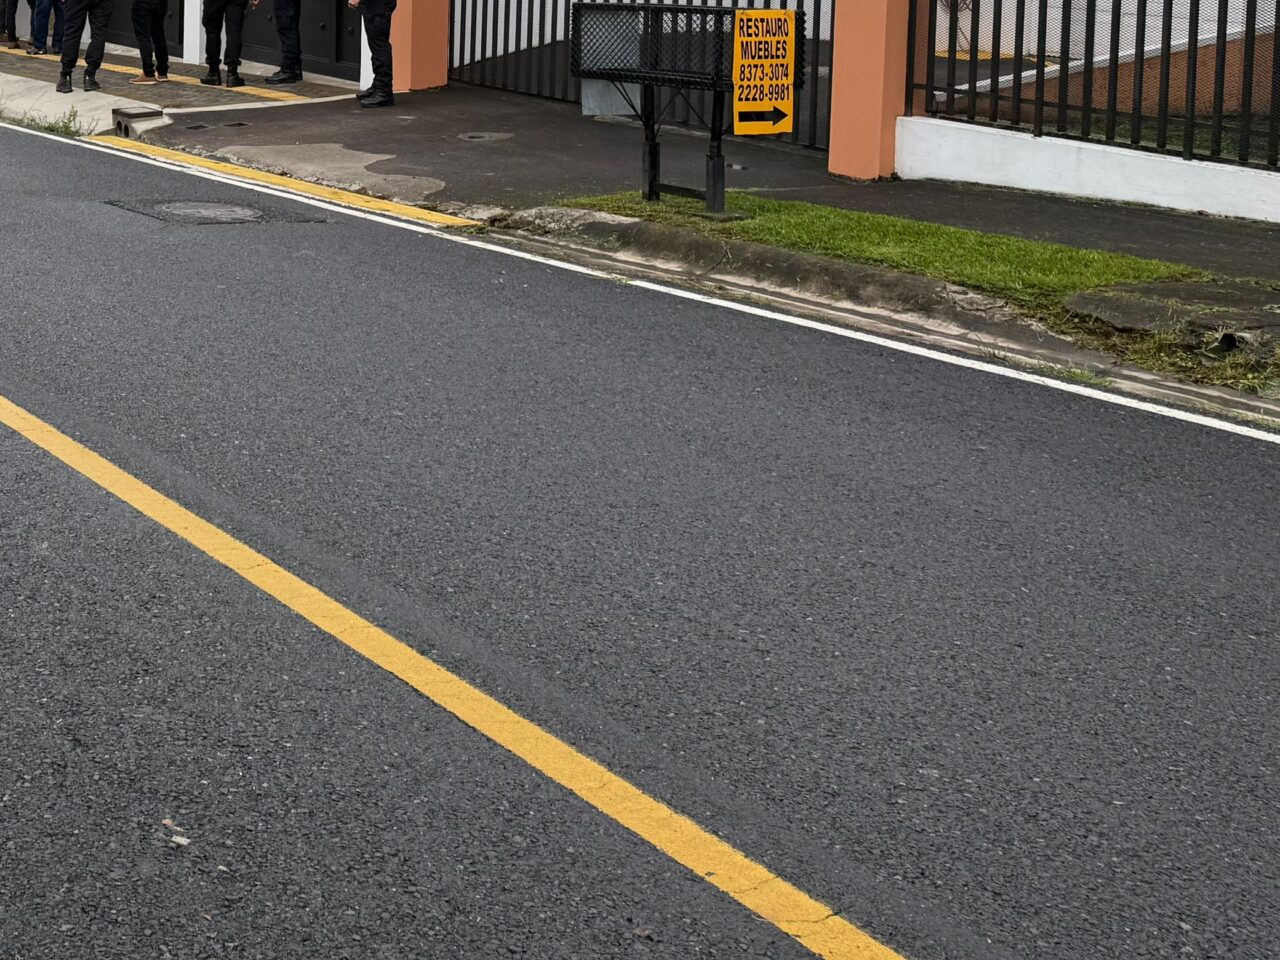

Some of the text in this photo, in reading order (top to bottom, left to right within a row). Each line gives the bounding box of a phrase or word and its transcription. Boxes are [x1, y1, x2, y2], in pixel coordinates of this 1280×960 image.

[739, 18, 789, 37] RESTAURO
[741, 40, 787, 60] MUEBLES
[740, 63, 789, 81] 8373-3074
[738, 83, 790, 101] 2228-9981
